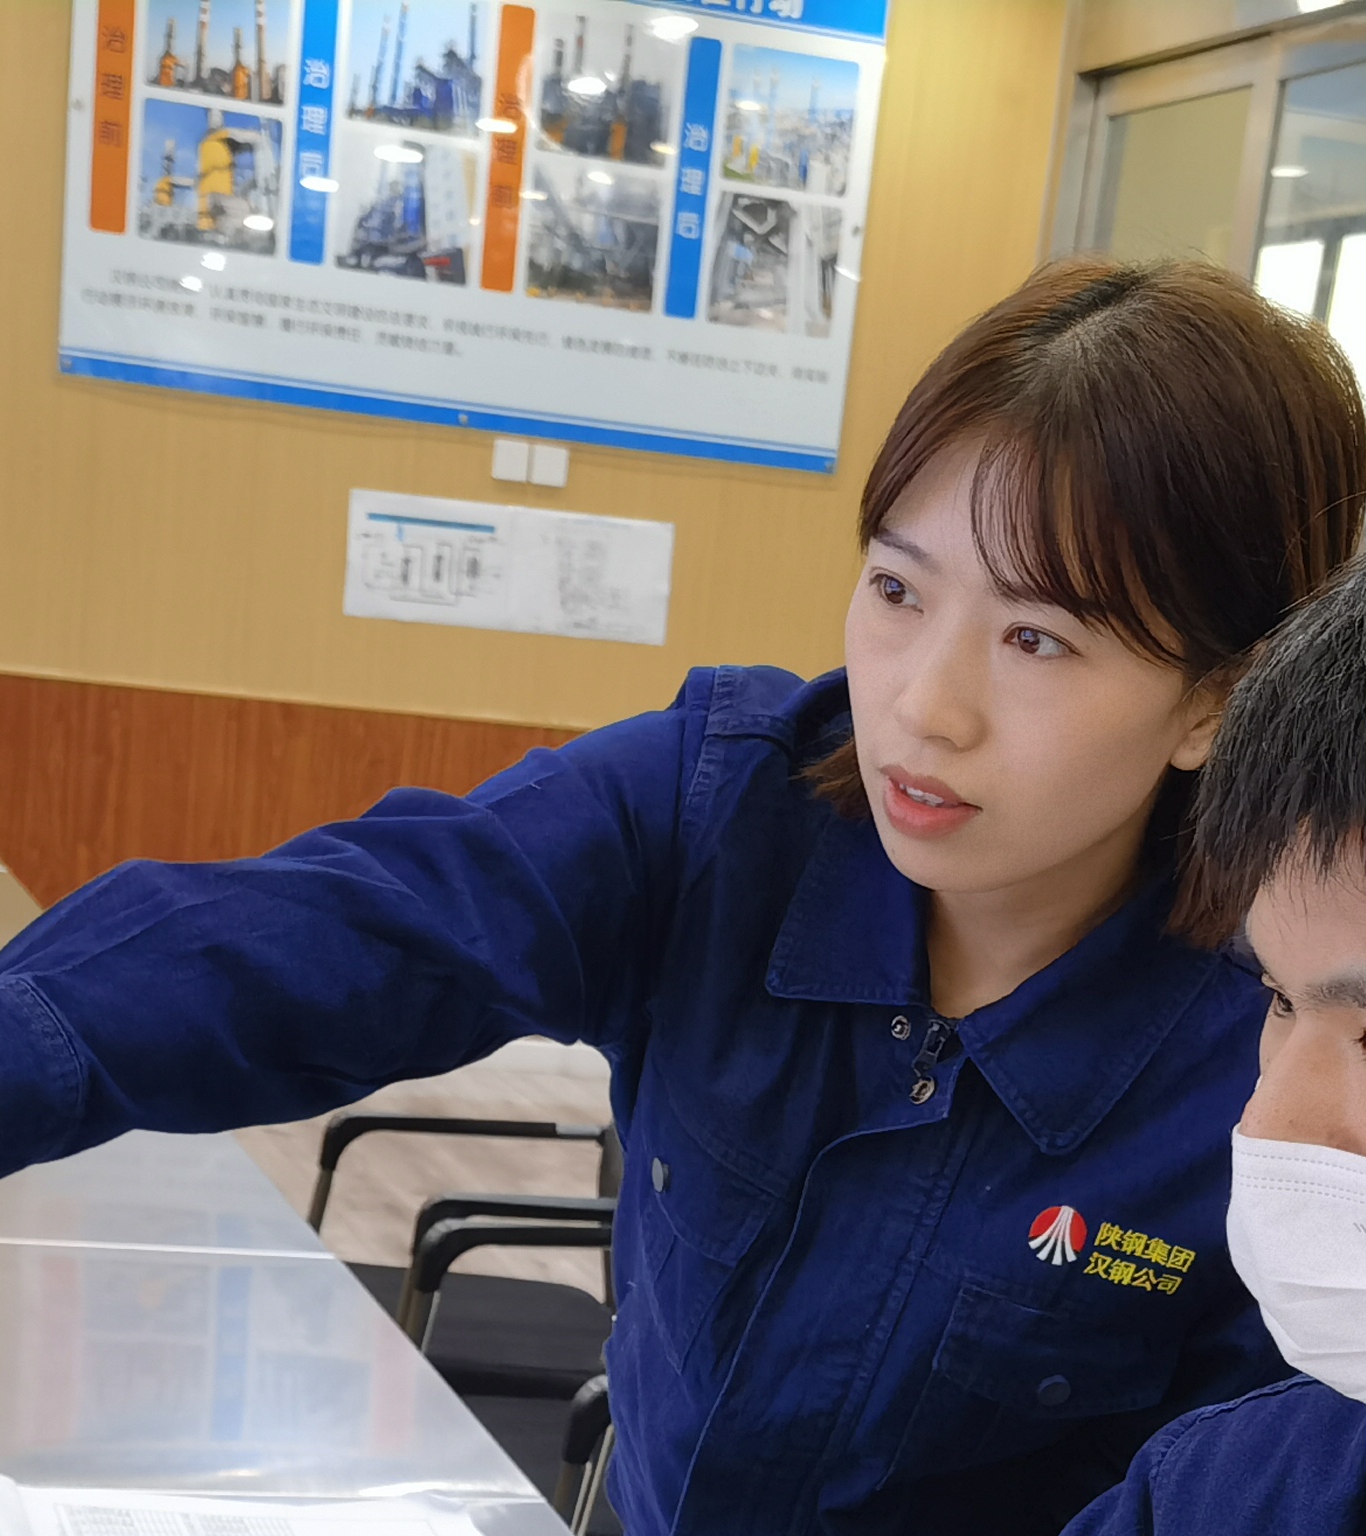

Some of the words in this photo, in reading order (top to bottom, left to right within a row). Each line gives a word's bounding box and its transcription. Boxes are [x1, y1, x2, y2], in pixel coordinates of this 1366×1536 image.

[1093, 1221, 1197, 1273] 陕钢集团
[1082, 1251, 1184, 1296] 汉钢公司
